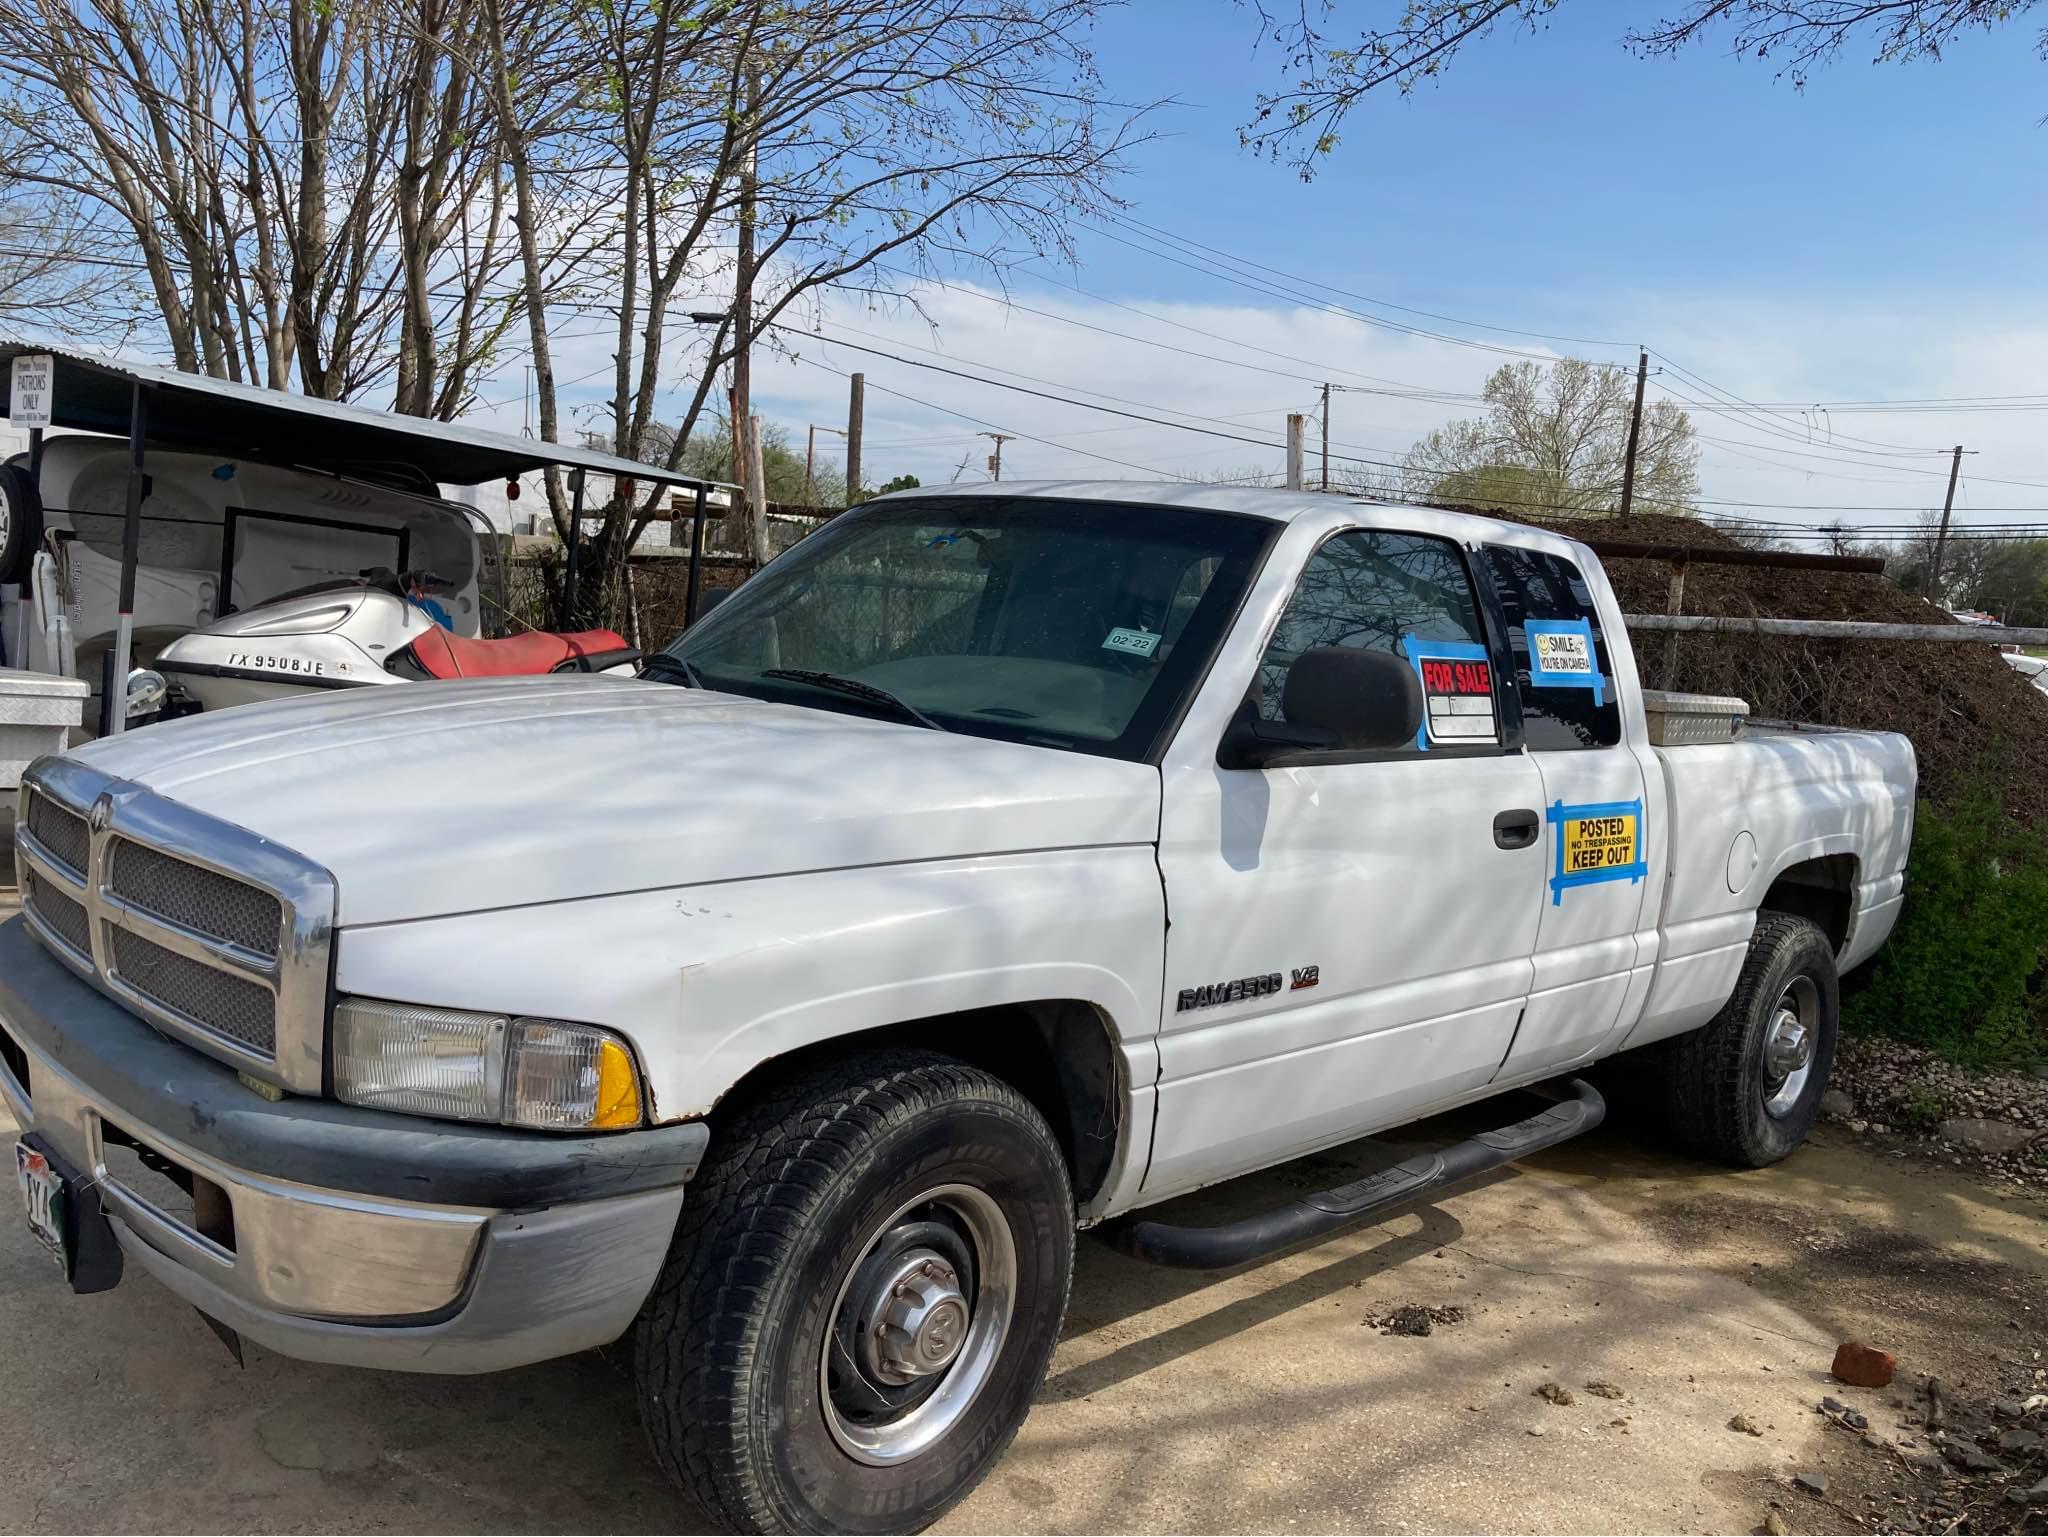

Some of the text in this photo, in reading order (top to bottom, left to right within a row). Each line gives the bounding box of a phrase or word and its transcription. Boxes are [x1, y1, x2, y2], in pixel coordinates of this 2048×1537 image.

[17, 374, 46, 391] PATRONS
[23, 394, 40, 410] ONLY
[1112, 635, 1129, 645] 02
[1131, 639, 1150, 649] 22
[1549, 636, 1575, 652] SMILE
[1541, 657, 1590, 670] YOU'RE ON CAMERA
[1423, 662, 1491, 693] FOR SALE
[1580, 818, 1624, 838] POSTED
[1571, 836, 1632, 850] NO TRESPASSING
[1573, 846, 1629, 868] KEEP OUT
[1176, 982, 1227, 1012] RAM
[1226, 973, 1283, 1000] 2500
